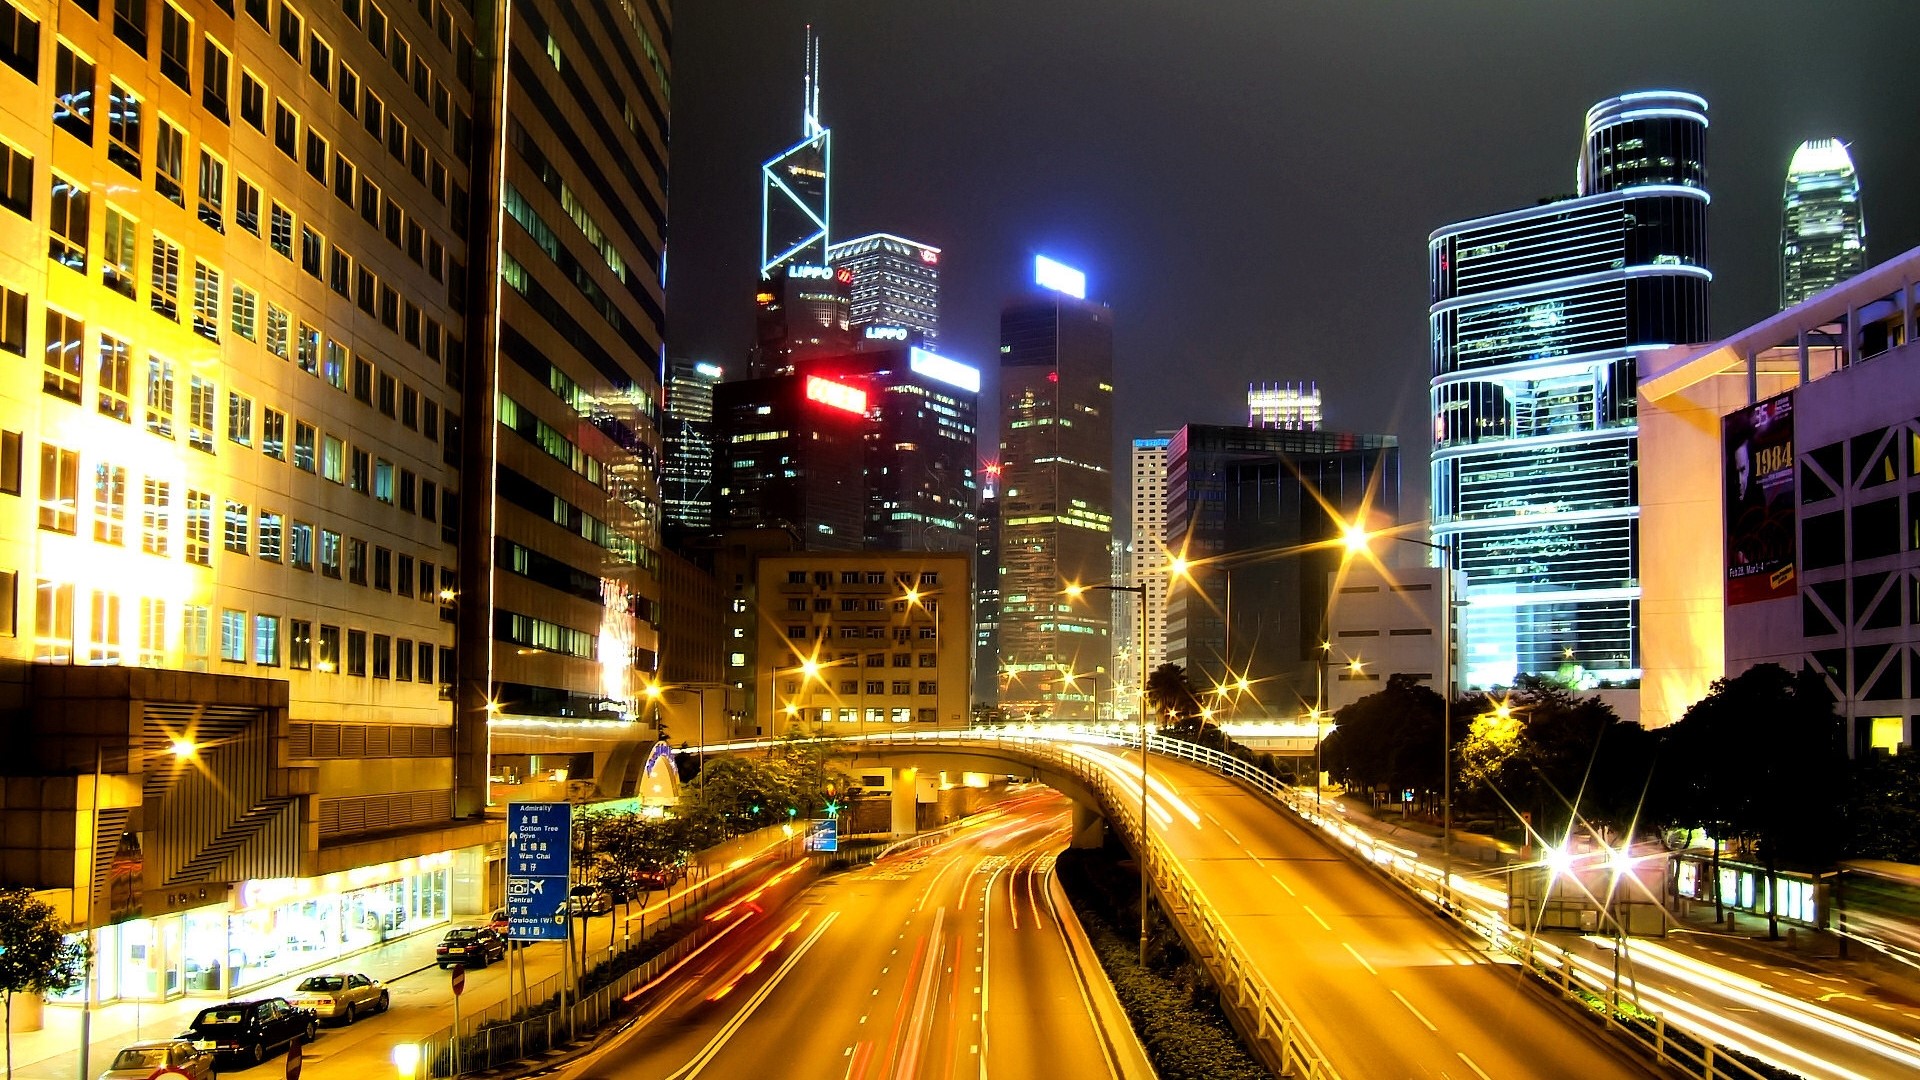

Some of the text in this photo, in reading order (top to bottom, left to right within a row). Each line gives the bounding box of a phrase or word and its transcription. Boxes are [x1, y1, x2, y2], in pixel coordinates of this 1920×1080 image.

[789, 265, 834, 280] LIPPO
[866, 327, 908, 340] LIPPO
[1756, 441, 1792, 476] 1984
